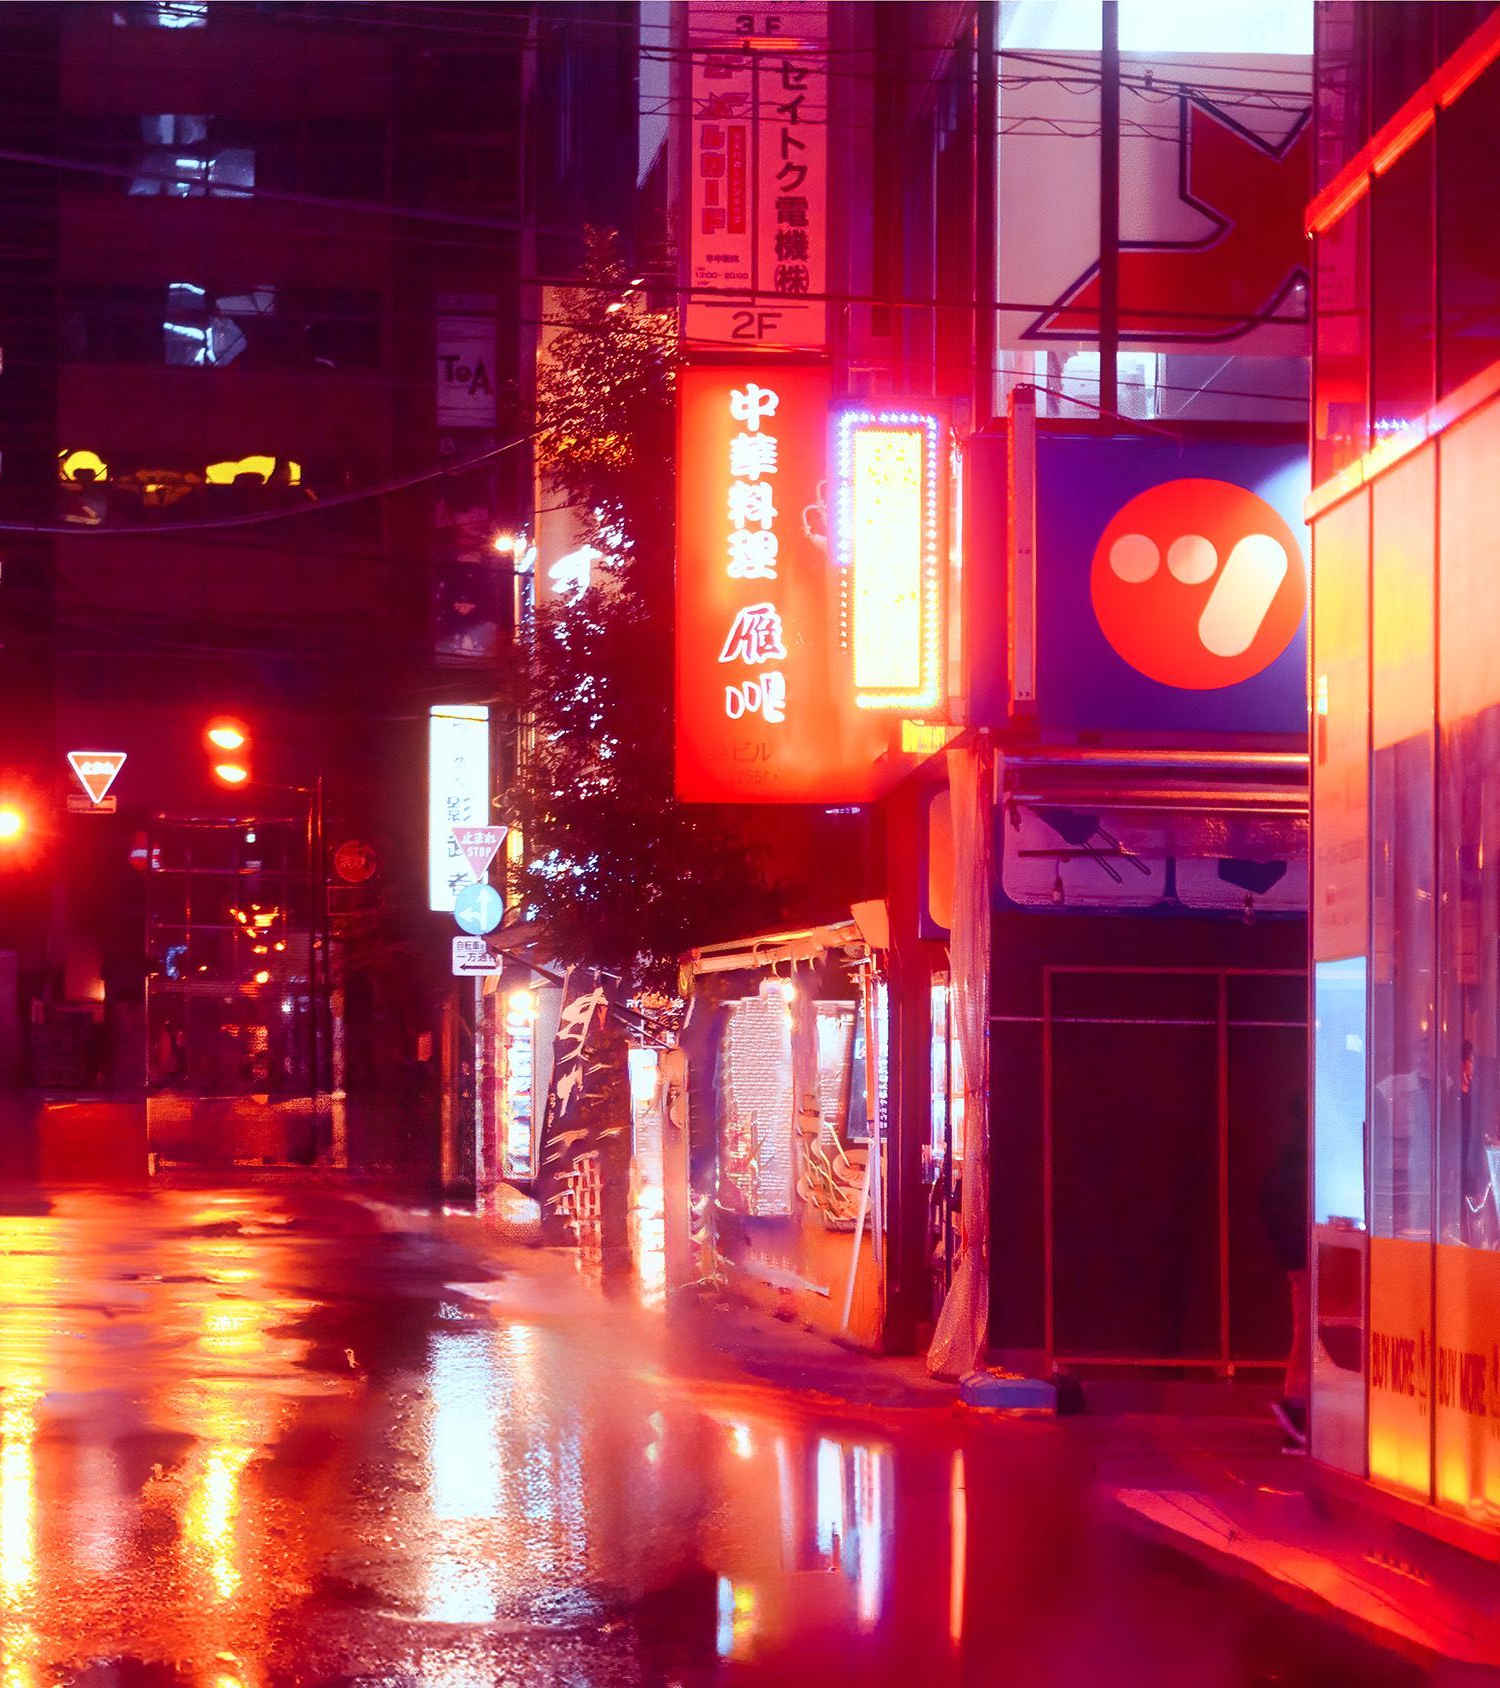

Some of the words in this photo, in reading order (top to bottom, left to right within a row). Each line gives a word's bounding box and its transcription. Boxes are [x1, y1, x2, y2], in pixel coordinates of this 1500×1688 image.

[731, 311, 783, 340] 2F
[725, 382, 780, 581] 中華料理
[462, 831, 497, 844] 止まれ
[467, 846, 492, 858] STOP
